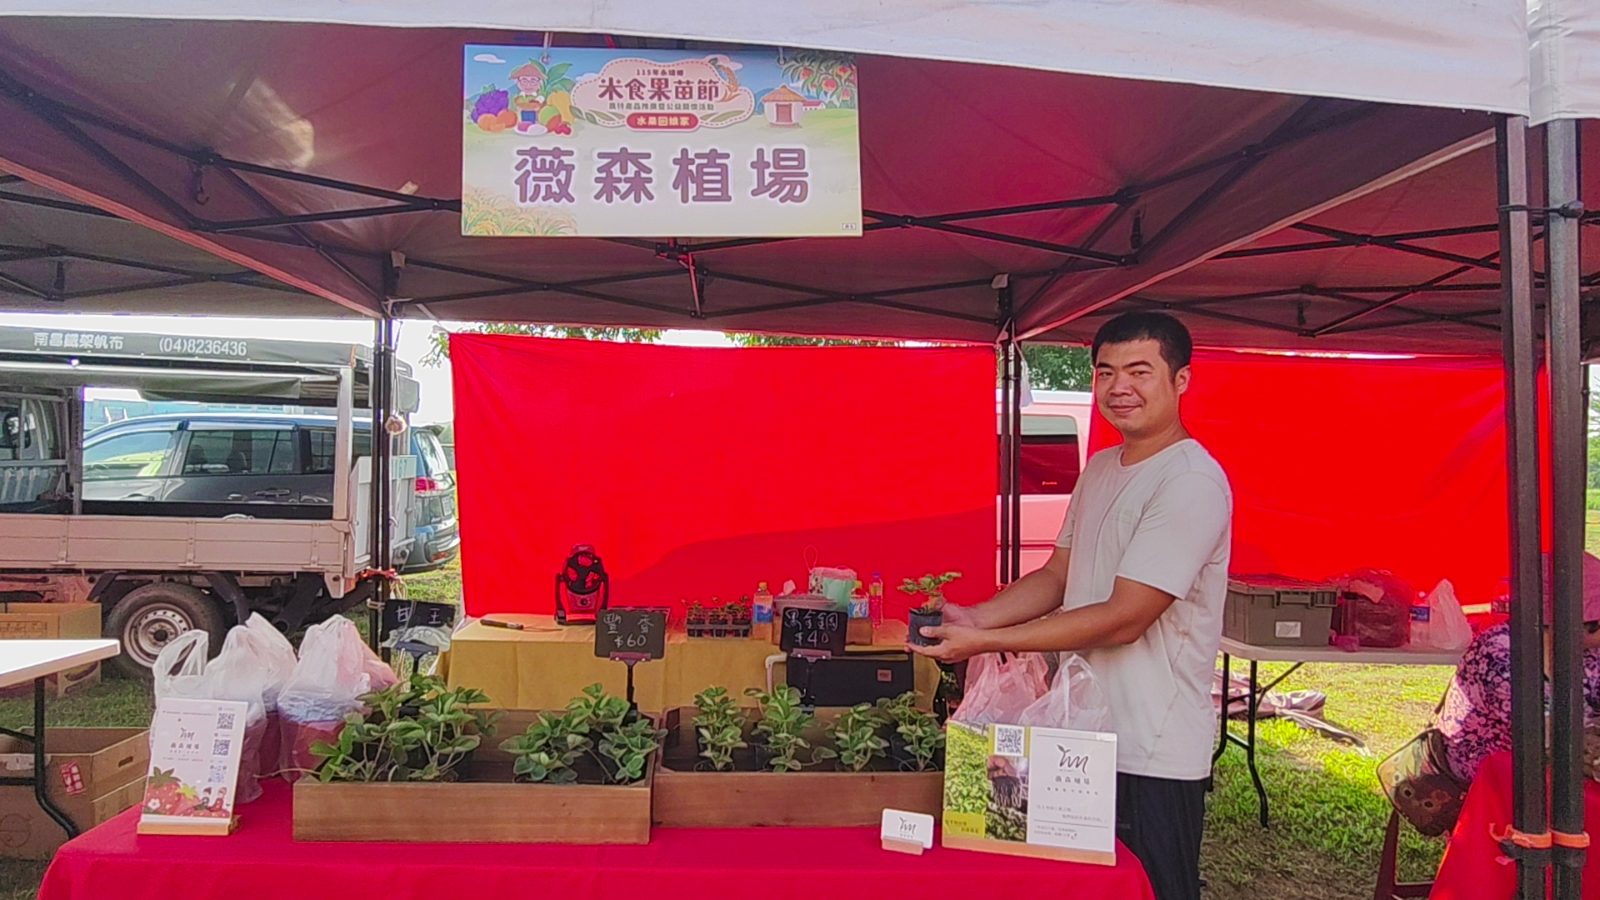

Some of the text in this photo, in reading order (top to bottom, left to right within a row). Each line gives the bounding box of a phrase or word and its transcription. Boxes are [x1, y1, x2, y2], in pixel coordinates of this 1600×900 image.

[598, 77, 719, 101] 米食果苗節
[636, 116, 690, 126] 水果回娘家
[514, 146, 809, 203] 薇森植場
[159, 337, 247, 356] (04)8236436
[613, 633, 647, 648] $60
[795, 630, 829, 647] $40
